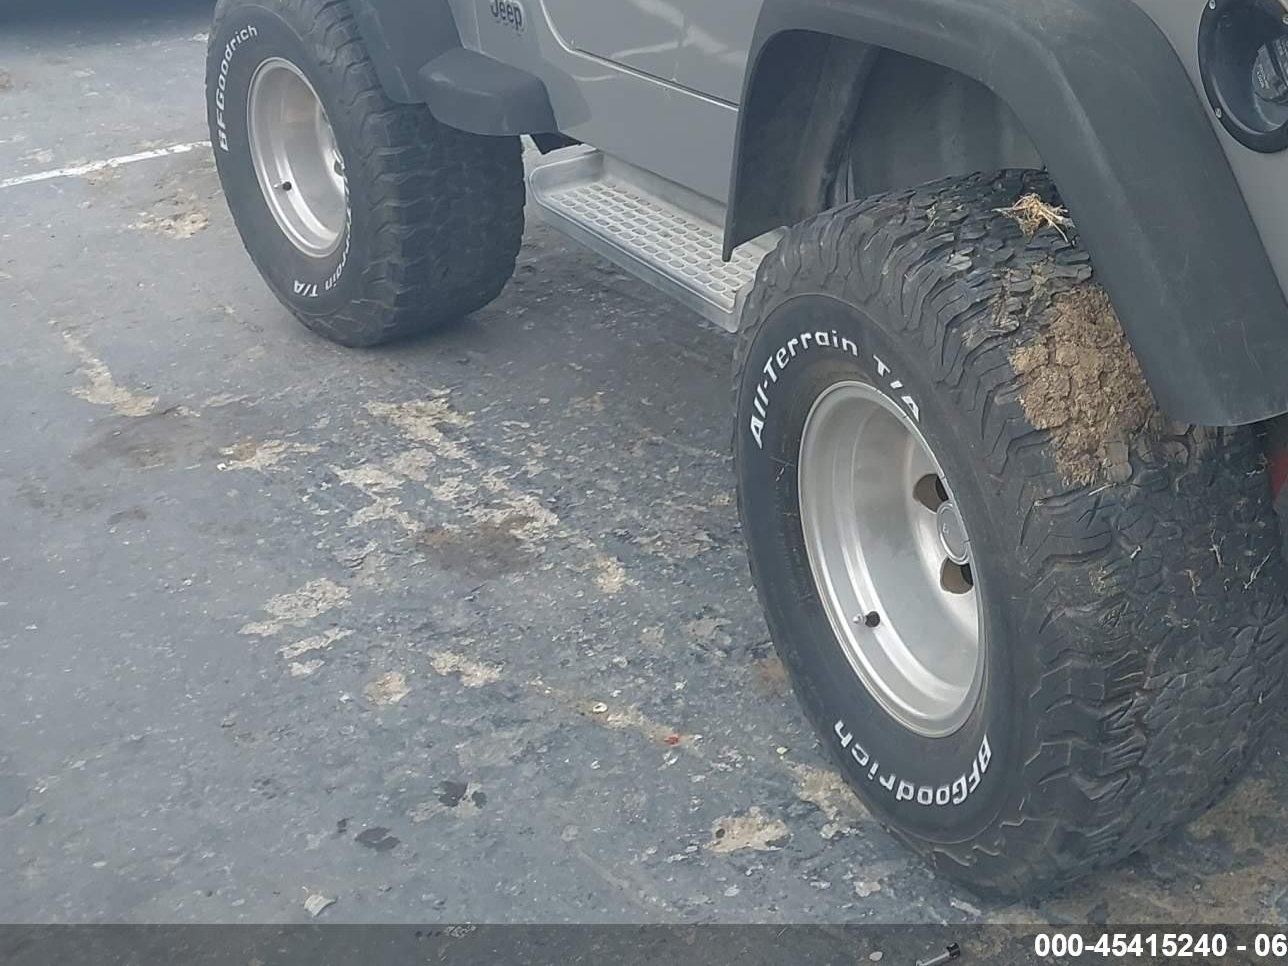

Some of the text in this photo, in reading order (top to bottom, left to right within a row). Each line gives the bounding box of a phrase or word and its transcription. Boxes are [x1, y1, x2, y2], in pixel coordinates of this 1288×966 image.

[215, 25, 258, 152] BFGoodrich
[748, 328, 922, 450] All-Terrain T/A
[832, 719, 993, 807] BFGoodrich
